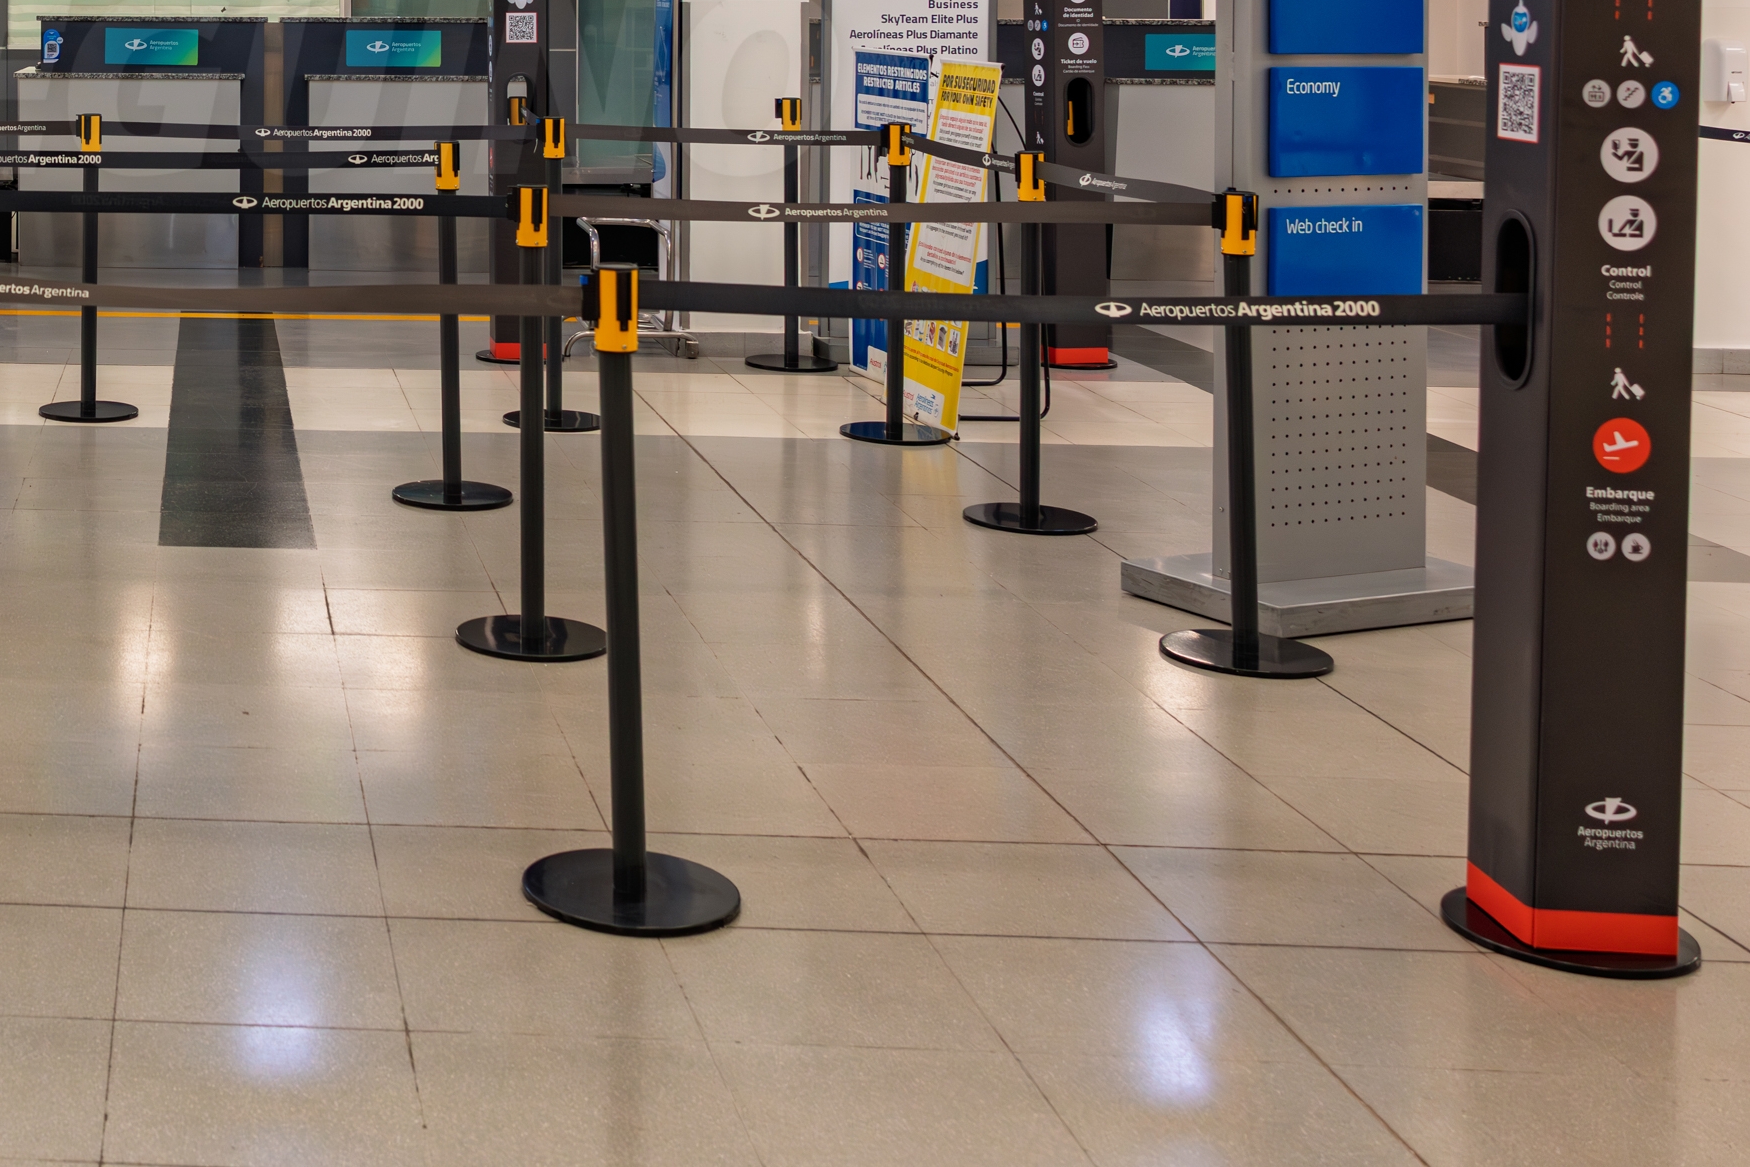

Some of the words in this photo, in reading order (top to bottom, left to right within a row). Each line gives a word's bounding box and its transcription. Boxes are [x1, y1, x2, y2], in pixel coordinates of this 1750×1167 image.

[928, 0, 979, 9] Business
[881, 14, 928, 26] SkyTeam
[931, 14, 954, 24] Elite
[956, 14, 978, 24] Plus
[850, 29, 904, 39] Aerolíneas
[906, 29, 928, 39] Plus
[930, 29, 978, 39] Diamante
[916, 45, 938, 55] Plus
[940, 45, 978, 55] Platino
[857, 63, 887, 75] ELEMENTOS
[887, 66, 927, 80] RESTRINGIDOS
[863, 76, 894, 89] RESTRICTED
[895, 81, 920, 93] ARTICLES
[1286, 79, 1341, 97] Economy
[940, 90, 950, 102] FOR
[950, 92, 961, 103] YOUR
[962, 94, 974, 106] OWN
[974, 95, 993, 108] SAFETY
[28, 153, 78, 165] Argentina
[78, 154, 102, 164] 2000
[262, 196, 327, 211] Aeropuertos
[327, 196, 392, 211] Argentina
[392, 197, 424, 210] 2000
[1286, 218, 1313, 234] Web
[1315, 217, 1349, 233] check
[1352, 217, 1363, 232] in
[1601, 264, 1652, 277] Control
[30, 281, 90, 299] Argentina
[1609, 280, 1642, 289] Control
[1606, 291, 1644, 301] Controle
[1139, 301, 1236, 320] Aeropuertos
[1237, 300, 1333, 321] Argentina
[1333, 300, 1380, 317] 2000
[1586, 486, 1655, 502] Embarque
[1590, 502, 1629, 513] Boarding
[1630, 504, 1650, 512] area
[1597, 513, 1642, 524] Embarque
[1577, 825, 1644, 839] Aeropuertos
[1584, 837, 1636, 850] Argentina
